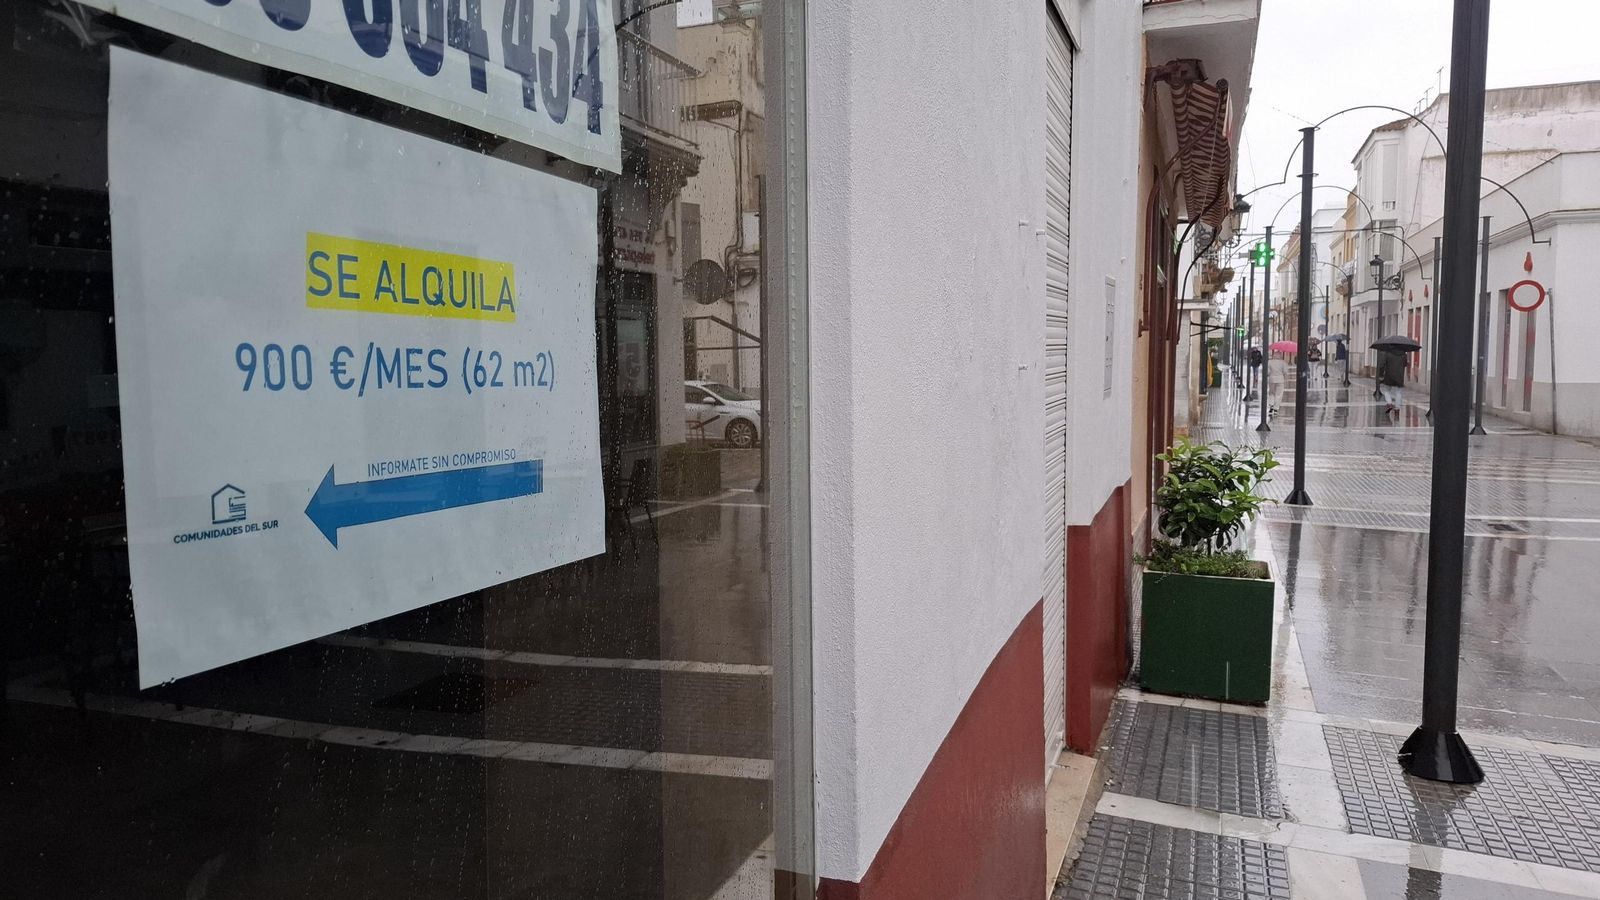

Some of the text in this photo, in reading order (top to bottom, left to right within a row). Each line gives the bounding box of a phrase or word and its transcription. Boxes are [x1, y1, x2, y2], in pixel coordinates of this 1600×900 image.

[308, 250, 516, 313] SE ALQUILA
[235, 342, 555, 398] 900 €/MES (62 m2)
[367, 448, 517, 477] INFORMATE SIN COMPROMISO
[173, 519, 279, 544] COMUNIDADES DEL SUR
